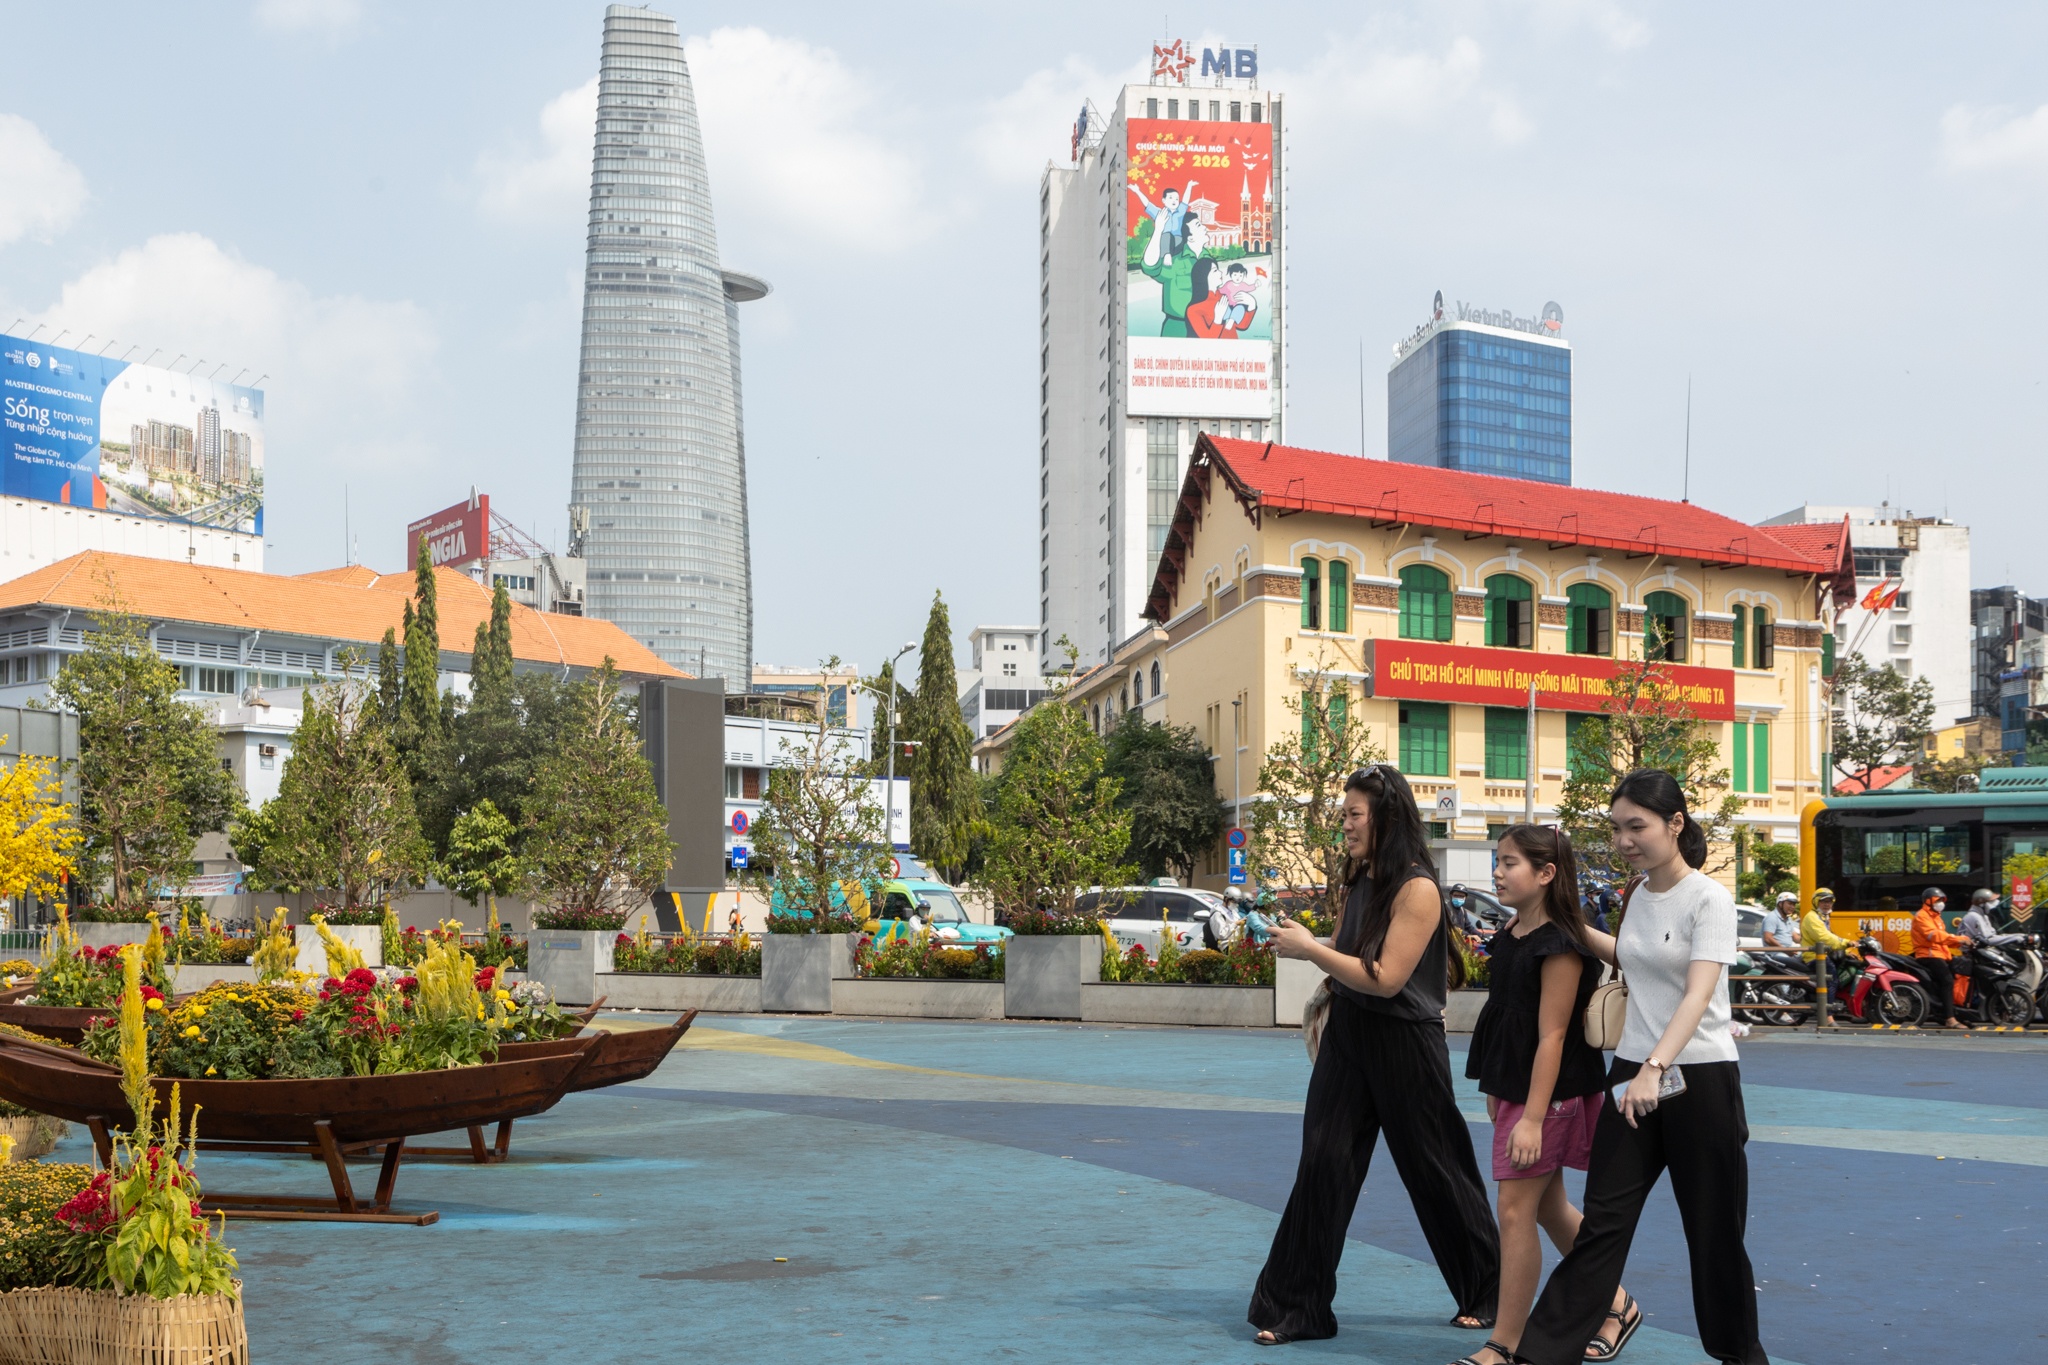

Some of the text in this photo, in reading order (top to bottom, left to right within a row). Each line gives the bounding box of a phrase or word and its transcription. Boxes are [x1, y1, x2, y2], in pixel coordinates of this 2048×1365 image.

[1202, 48, 1258, 78] MB
[1136, 141, 1157, 151] CHÚC
[1160, 142, 1185, 152] MỪNG
[1192, 155, 1230, 168] 2026
[1457, 299, 1542, 335] VietinBank
[4, 352, 24, 360] GLOBAL
[5, 379, 93, 403] MASTERI COSMO CENTRAL
[4, 397, 93, 427] Sống trọn vẹn
[27, 424, 45, 436] nhịp
[46, 428, 67, 440] cộng
[14, 443, 61, 459] The Global City
[14, 453, 31, 463] Trung
[45, 458, 55, 466] TP.
[76, 464, 92, 472] Minh
[1390, 657, 1412, 681] CHỦ
[1413, 662, 1438, 685] TỊCH
[1439, 661, 1455, 684] HỒ
[1455, 664, 1474, 685] CHÍ
[1475, 668, 1502, 688] MINH
[1503, 668, 1515, 689] VĨ
[1515, 671, 1532, 694] ĐẠI
[1533, 669, 1560, 693] SỐNG
[1561, 673, 1580, 694] MÃI
[1682, 684, 1712, 704] CHÚNG
[1713, 687, 1726, 705] TA
